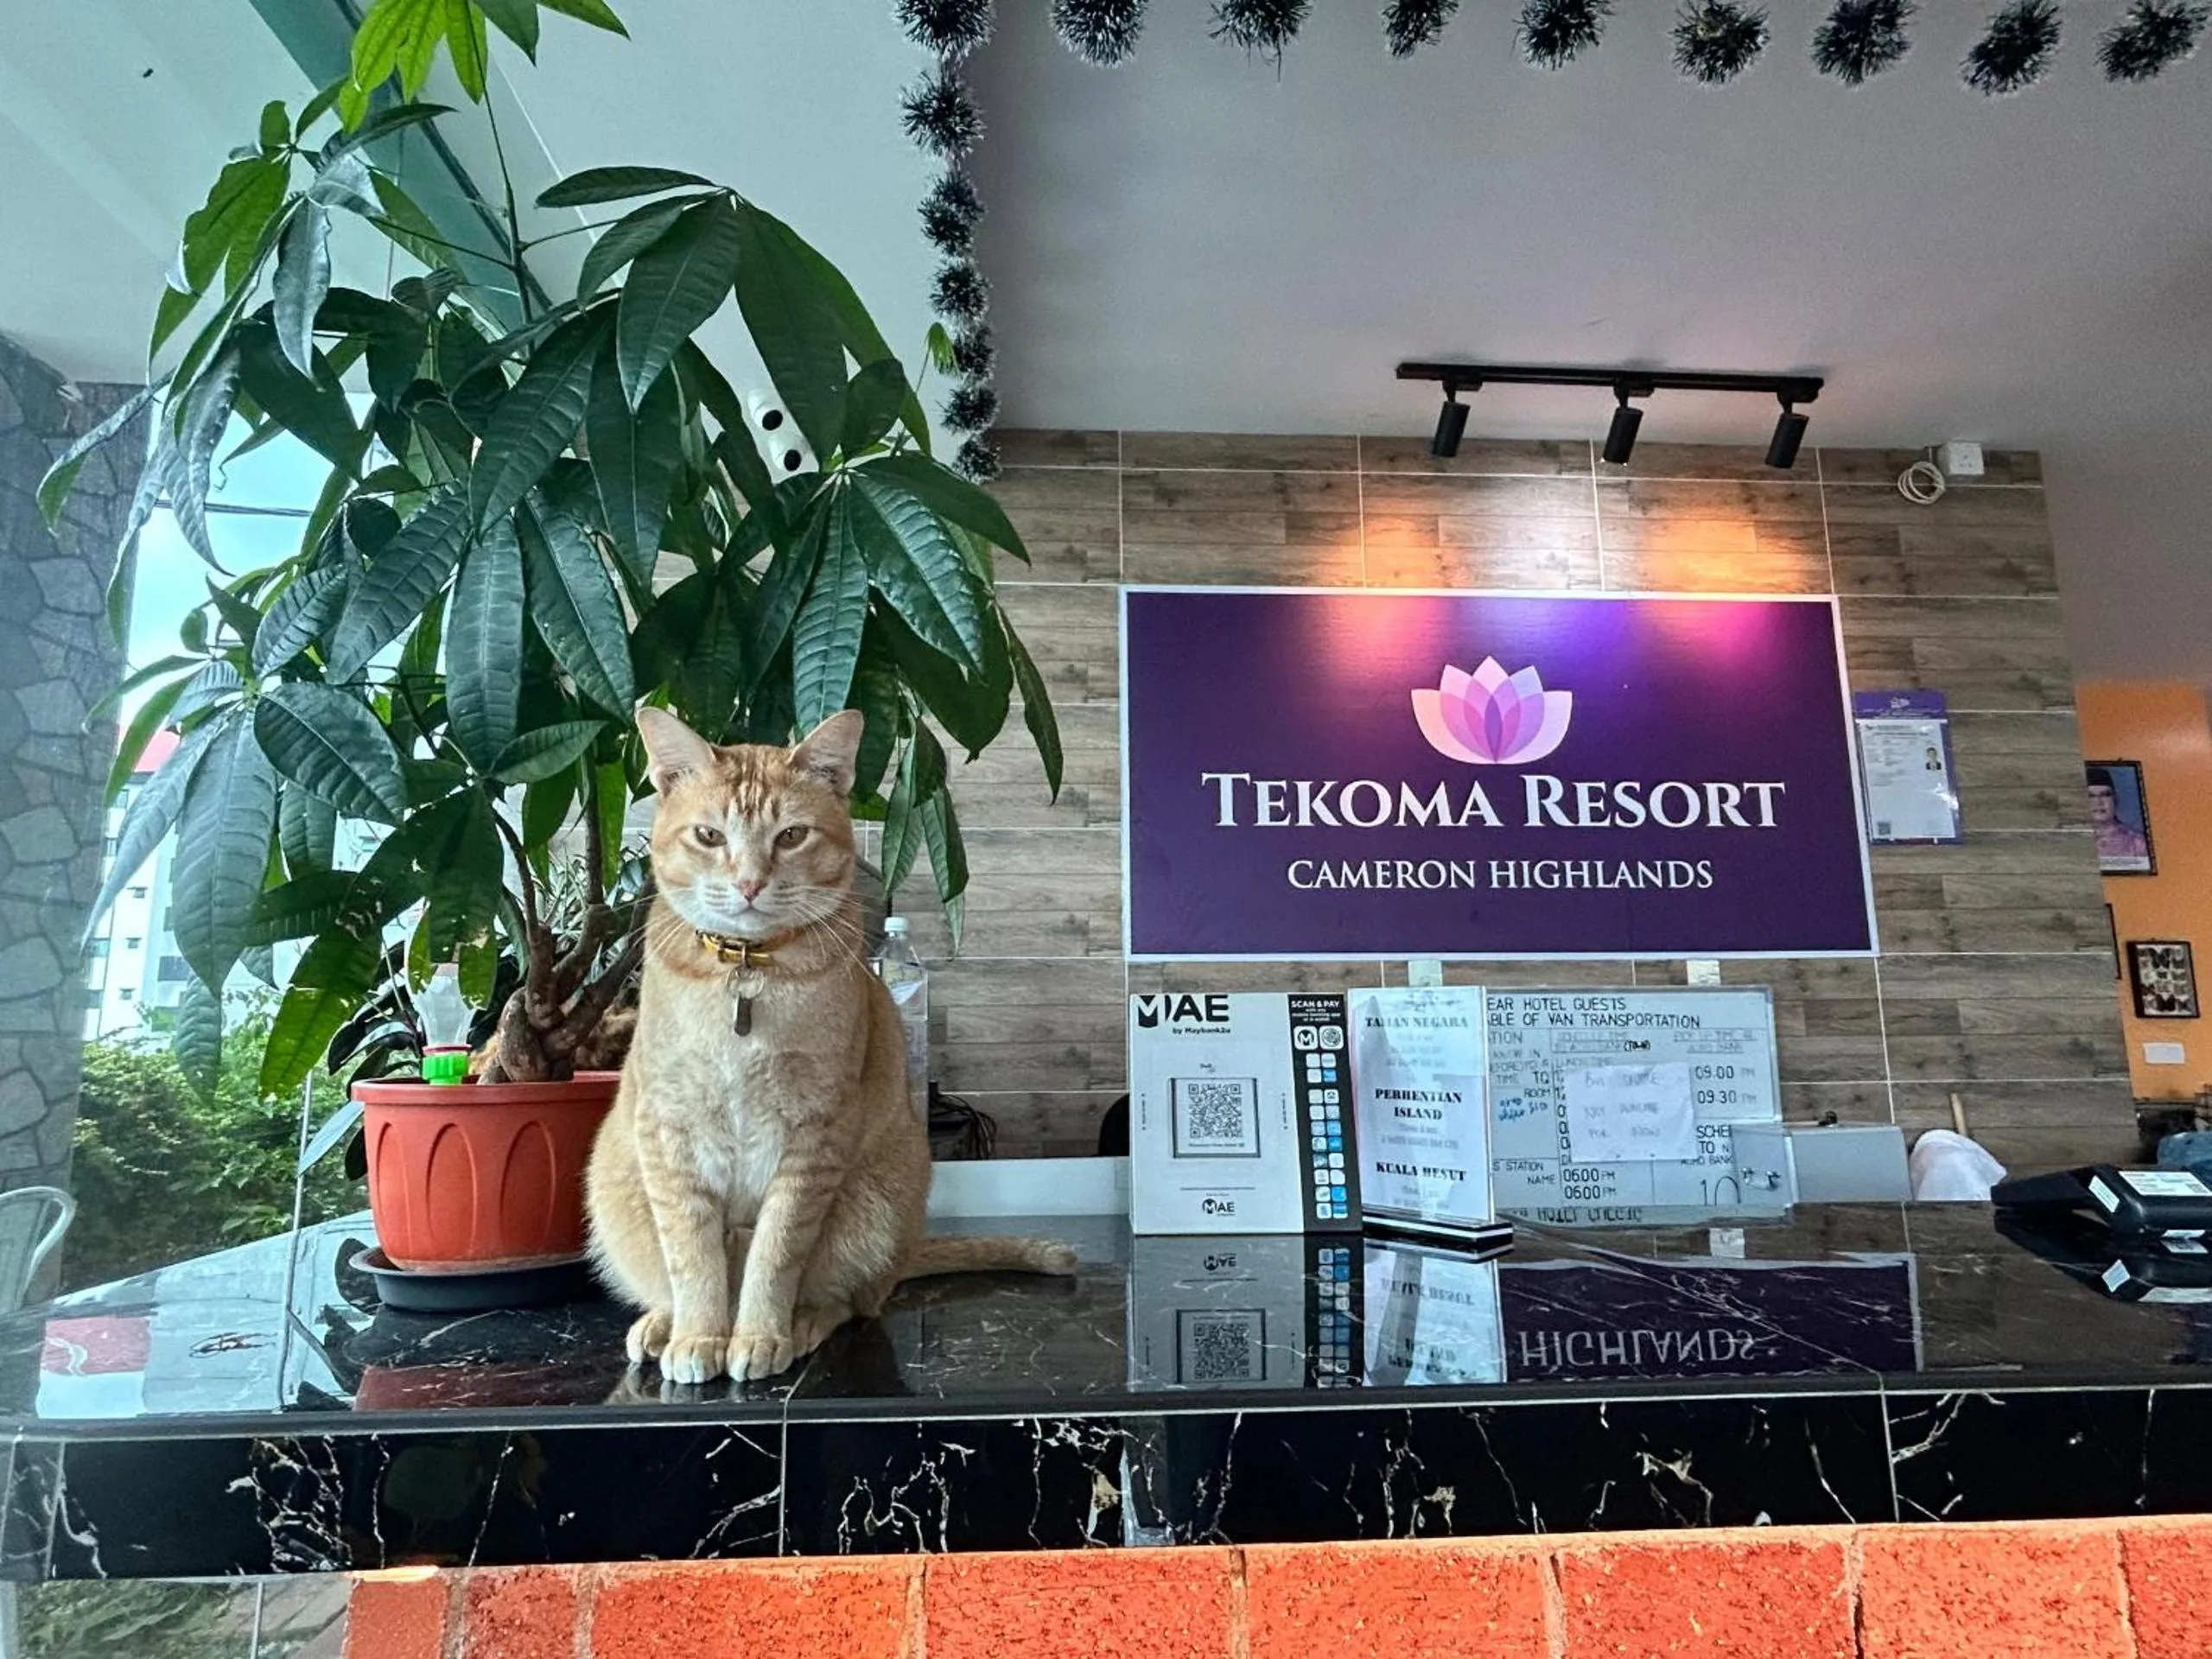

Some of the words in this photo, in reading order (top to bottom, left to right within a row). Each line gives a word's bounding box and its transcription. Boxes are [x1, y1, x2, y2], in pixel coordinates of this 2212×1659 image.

[1201, 772, 1504, 829] TEKOMA
[1523, 774, 1786, 830] RESORT
[1287, 860, 1476, 891] CAMERON
[1488, 860, 1713, 891] HIGHLANDS
[1291, 1000, 1316, 1008] SCAN
[1324, 1000, 1340, 1008] PAY
[1486, 997, 1514, 1011] EAR
[1523, 997, 1567, 1011] HOTEL
[1573, 996, 1627, 1011] GUESTS
[1487, 1013, 1514, 1027] BLE
[1522, 1013, 1540, 1027] OF
[1548, 1013, 1573, 1026] VAN
[1582, 1013, 1700, 1029] TRANSPORTATION
[1487, 1031, 1523, 1045] TION
[1375, 1088, 1463, 1104] PERHENTIAN
[1394, 1104, 1443, 1122] ISLAND
[1698, 1141, 1716, 1154] TO
[1376, 1161, 1418, 1177] KUALA
[1506, 1161, 1544, 1172] STATION
[1528, 1174, 1556, 1185] NAME
